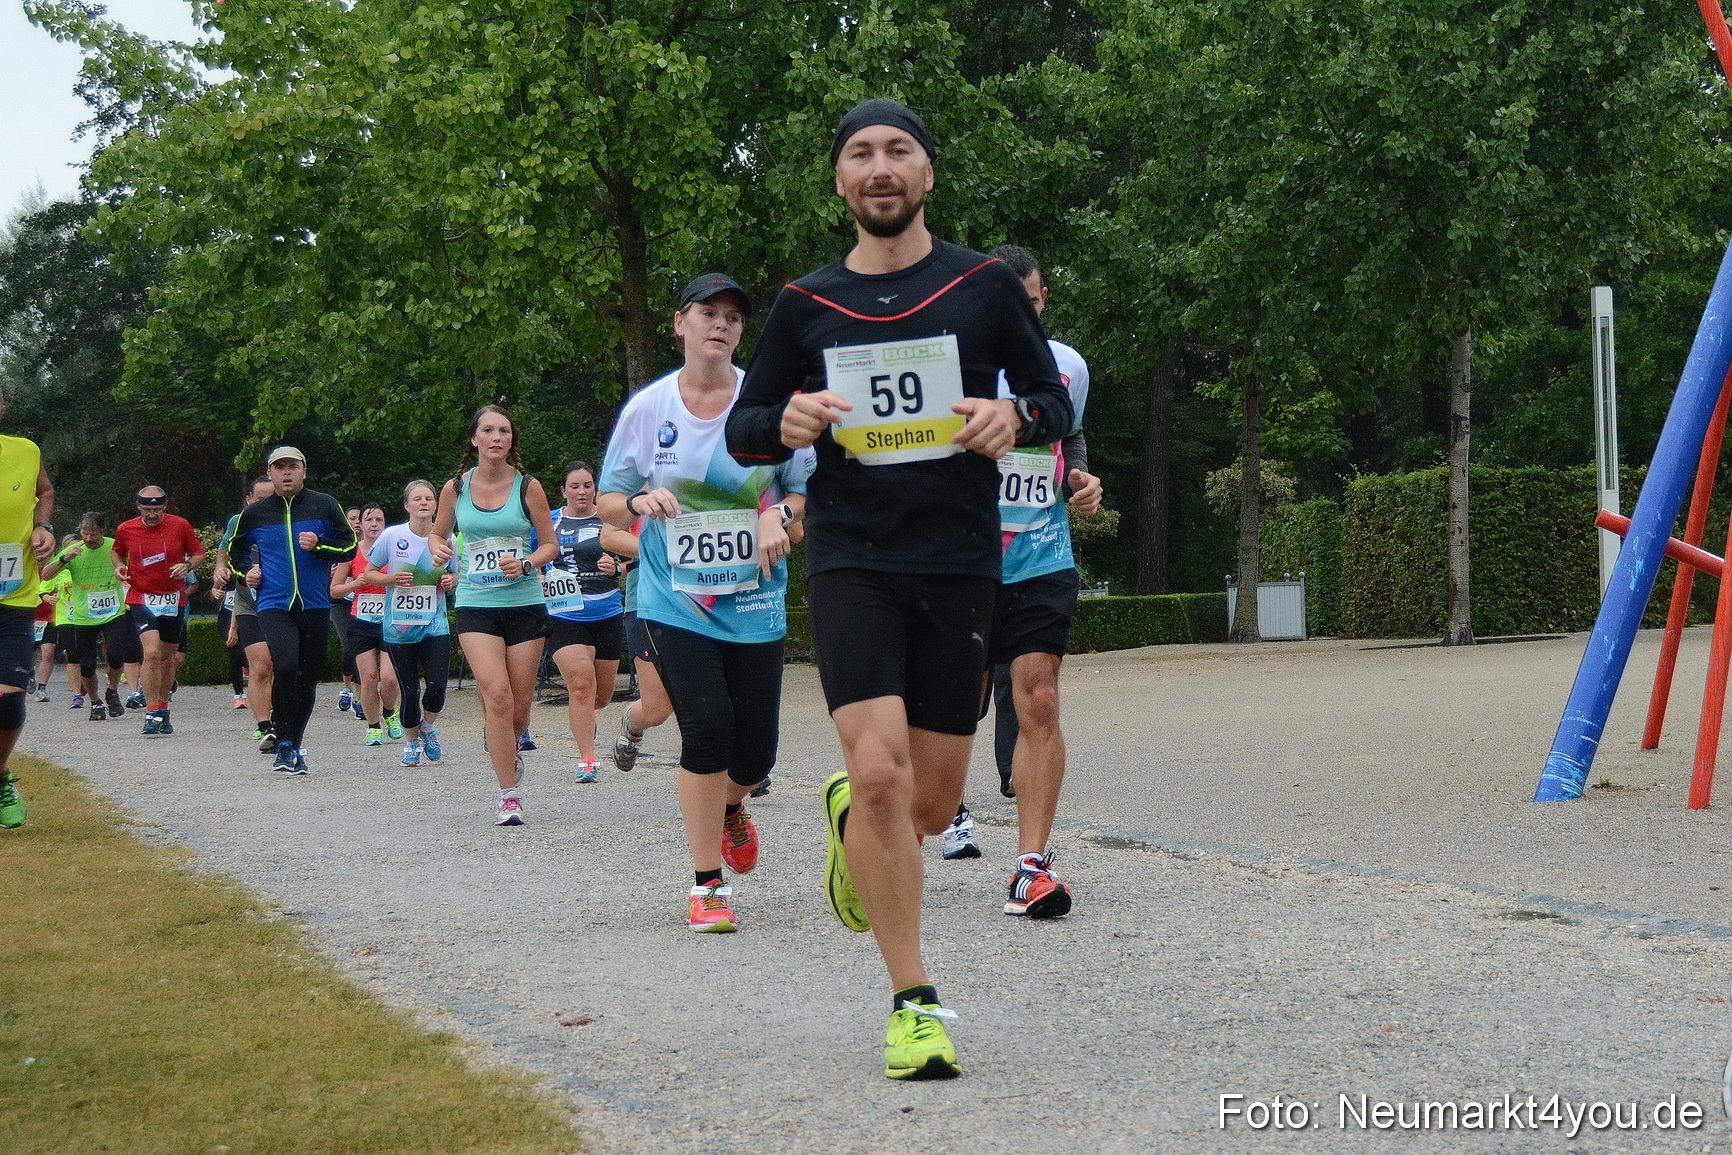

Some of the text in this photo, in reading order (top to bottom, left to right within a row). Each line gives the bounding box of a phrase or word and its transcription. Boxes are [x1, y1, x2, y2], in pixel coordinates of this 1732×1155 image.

[883, 343, 946, 362] BOCK
[870, 372, 924, 418] 59
[866, 428, 935, 449] Stephan
[655, 452, 678, 460] PARTL
[1019, 457, 1050, 468] BOCK
[707, 513, 749, 524] BOCK
[678, 530, 753, 565] 2650
[697, 570, 737, 585] Angela
[91, 596, 115, 608] 2401
[149, 593, 177, 605] 2793
[396, 595, 432, 609] 2591
[736, 591, 776, 603] Neumarkter
[736, 601, 773, 613] Stadtlauf
